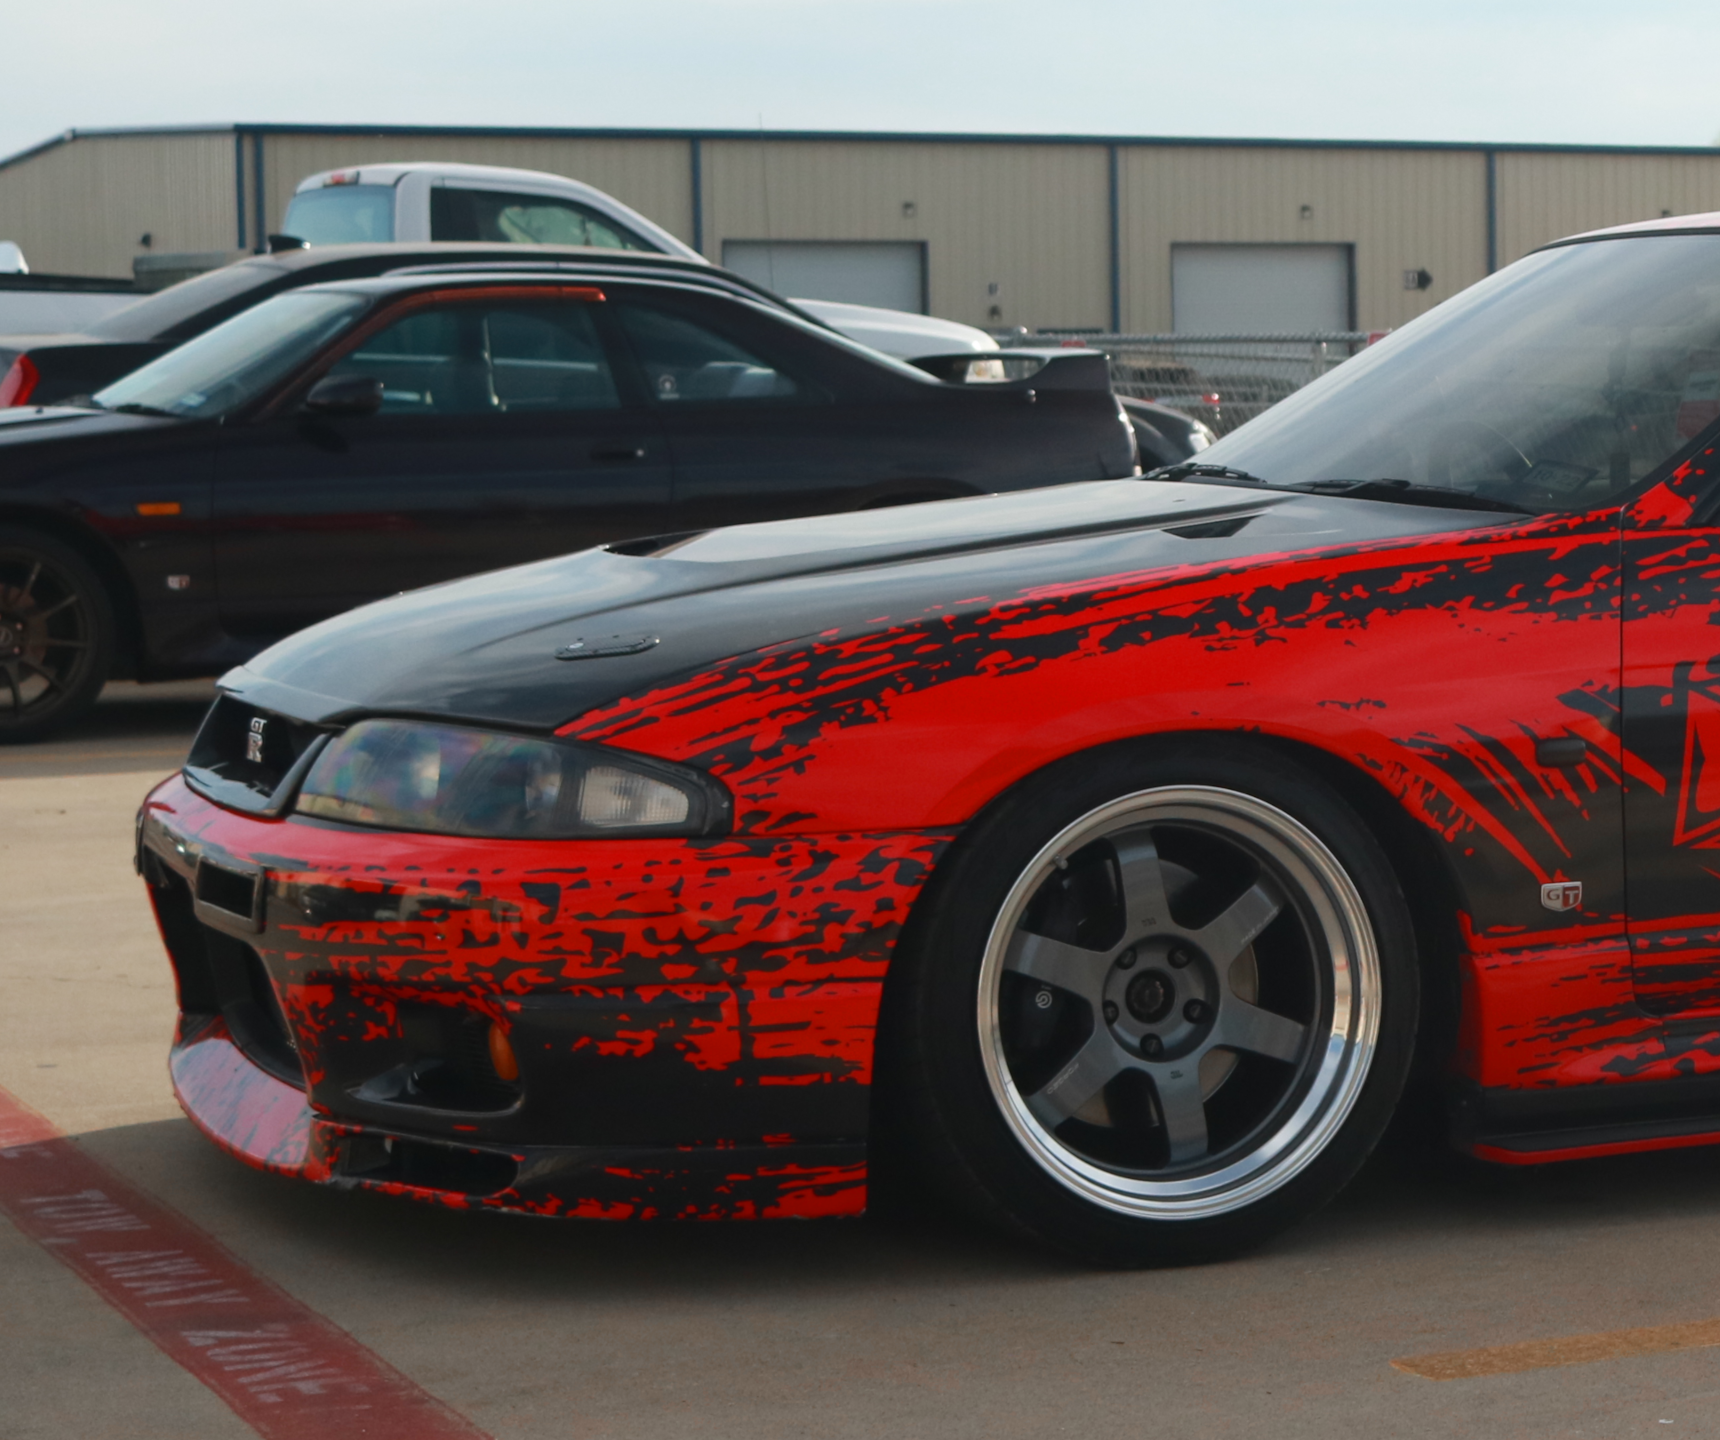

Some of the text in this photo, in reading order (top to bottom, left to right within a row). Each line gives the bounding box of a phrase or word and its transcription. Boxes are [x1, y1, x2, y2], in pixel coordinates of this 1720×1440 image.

[1546, 888, 1579, 905] GT
[84, 1249, 251, 1308] AWAY
[180, 1322, 370, 1404] ZONE
